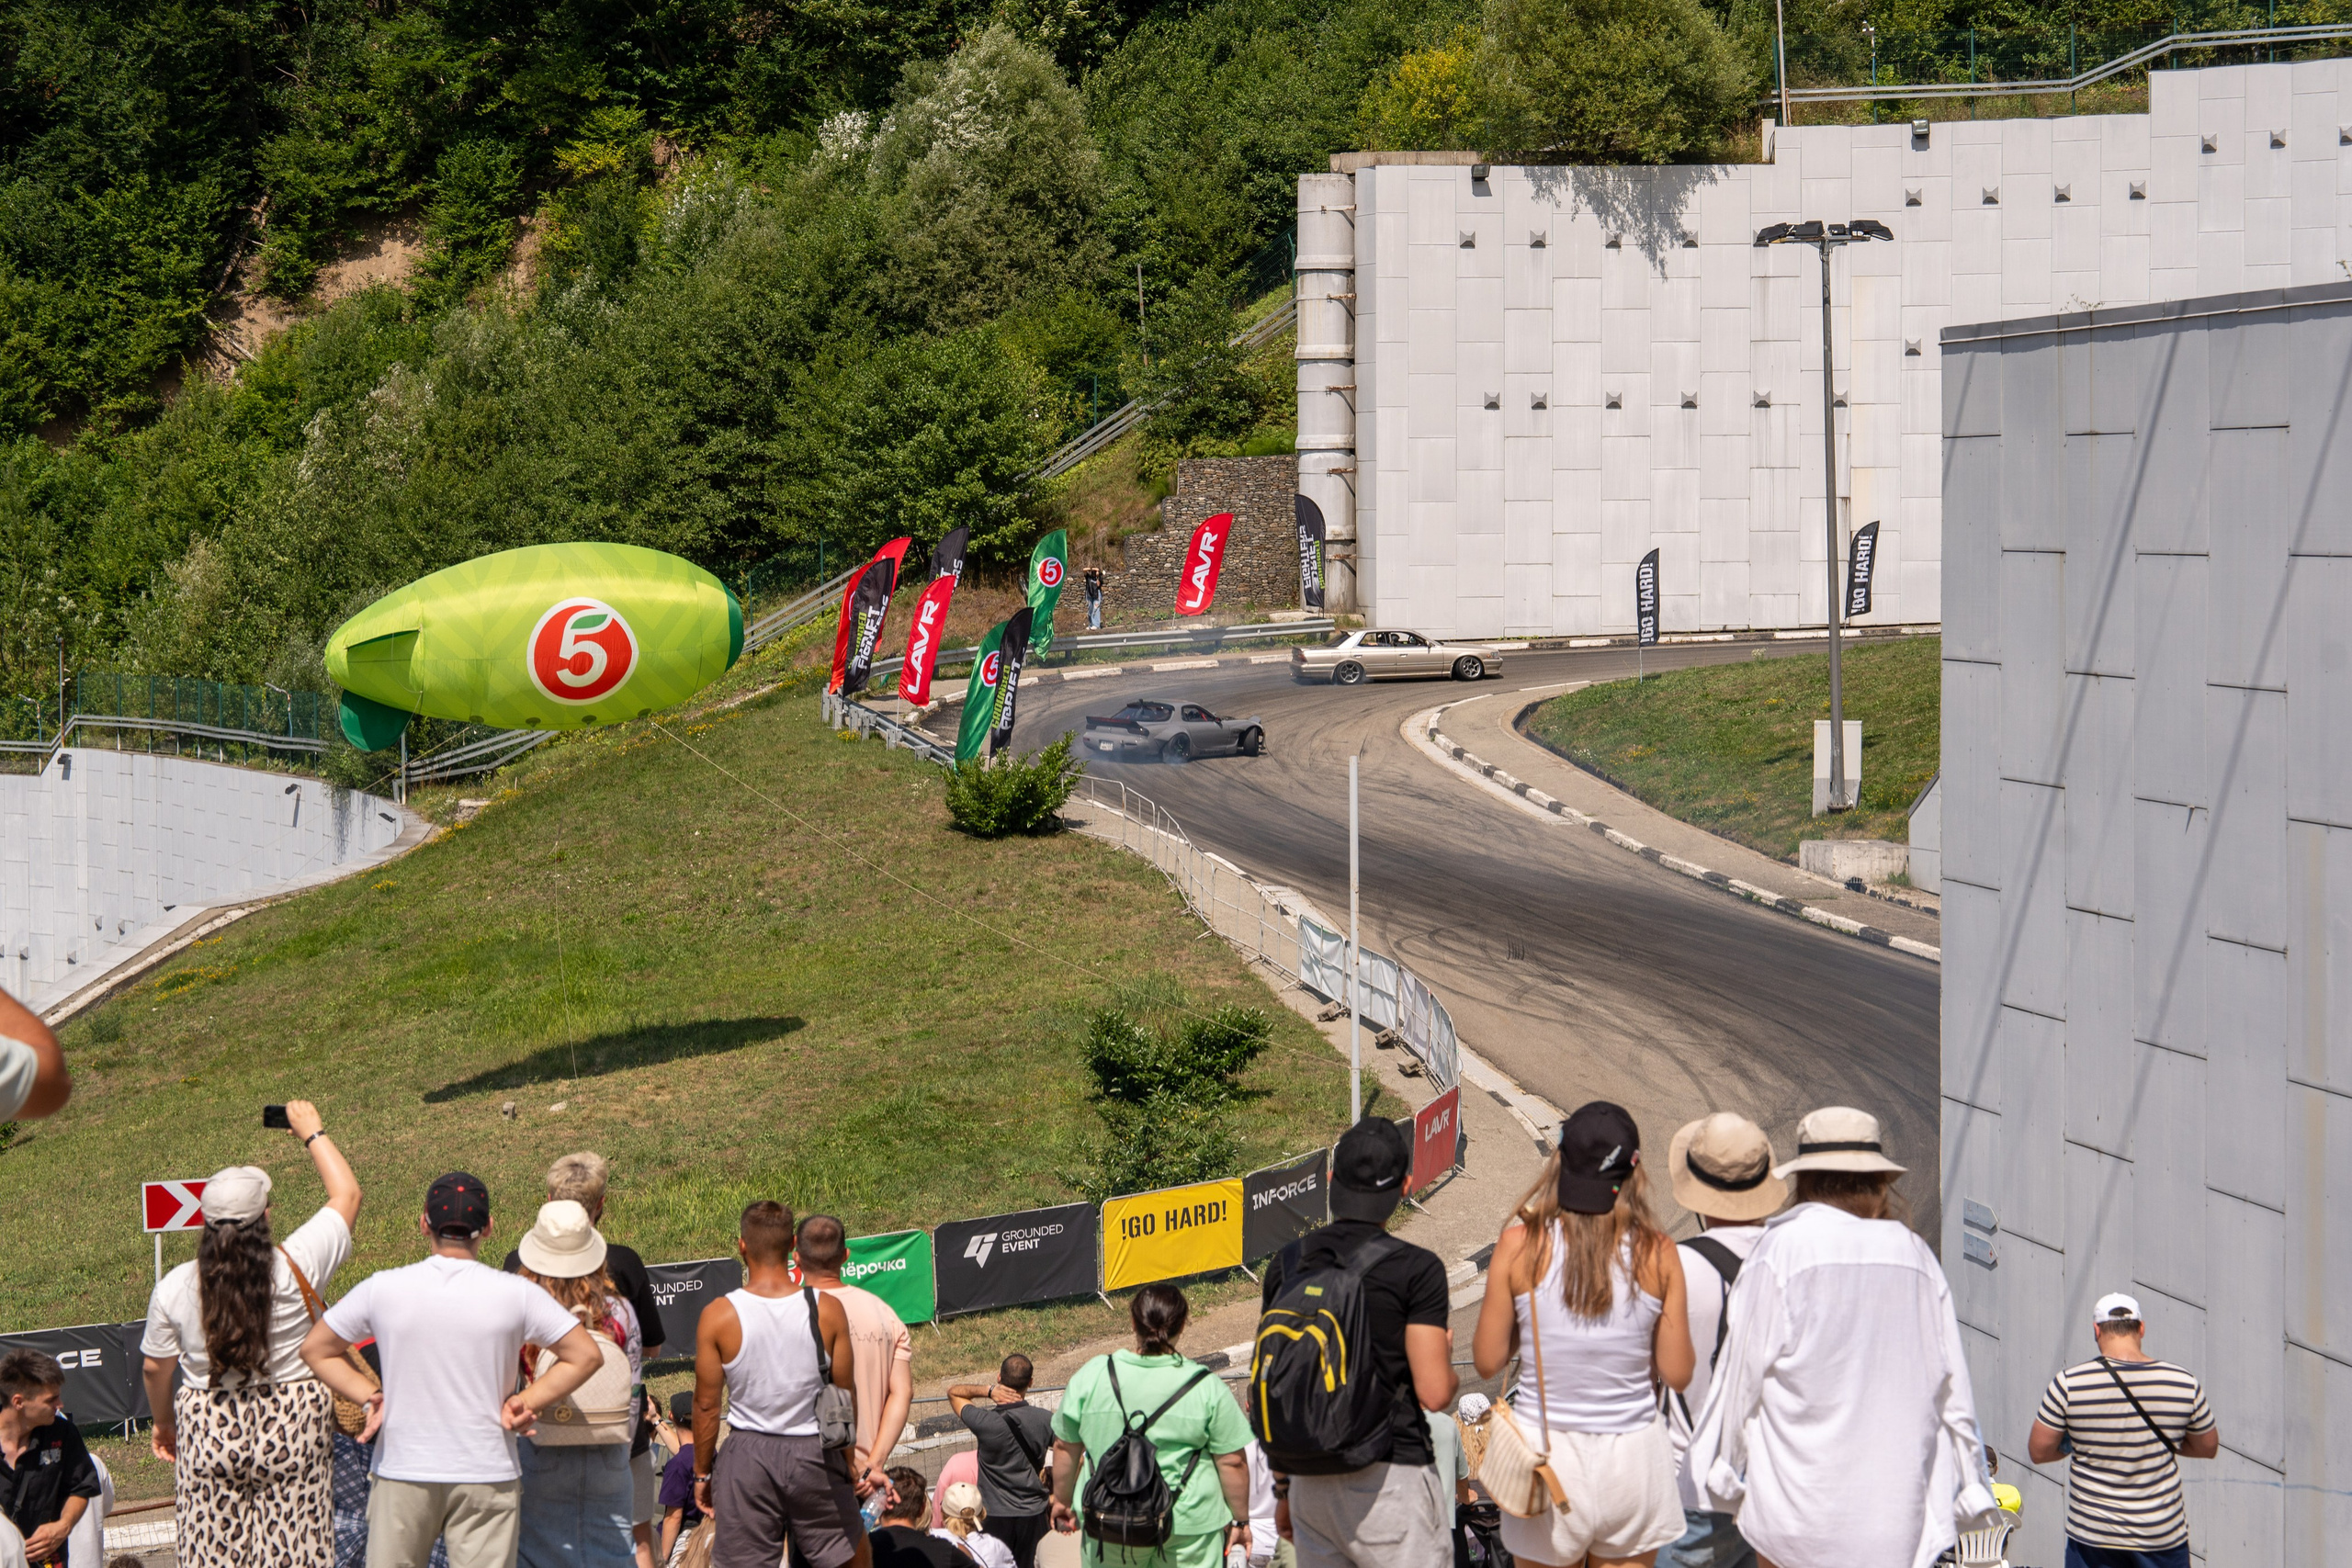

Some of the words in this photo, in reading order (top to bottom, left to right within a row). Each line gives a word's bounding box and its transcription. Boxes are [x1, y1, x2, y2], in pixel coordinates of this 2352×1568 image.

[1045, 559, 1057, 583] 5
[1185, 532, 1219, 608] LAVR
[1854, 535, 1873, 583] HARD!
[1639, 562, 1654, 612] HARD!
[556, 608, 614, 688] 5
[908, 600, 940, 695] LAVR
[1640, 615, 1655, 643] !GO
[1425, 1109, 1451, 1142] LAVR
[1252, 1173, 1317, 1211] INFORCE
[1001, 1224, 1064, 1242] GROUNDED
[1121, 1213, 1156, 1241] !GO
[1165, 1200, 1227, 1232] HARD!
[1002, 1238, 1040, 1253] EVENT
